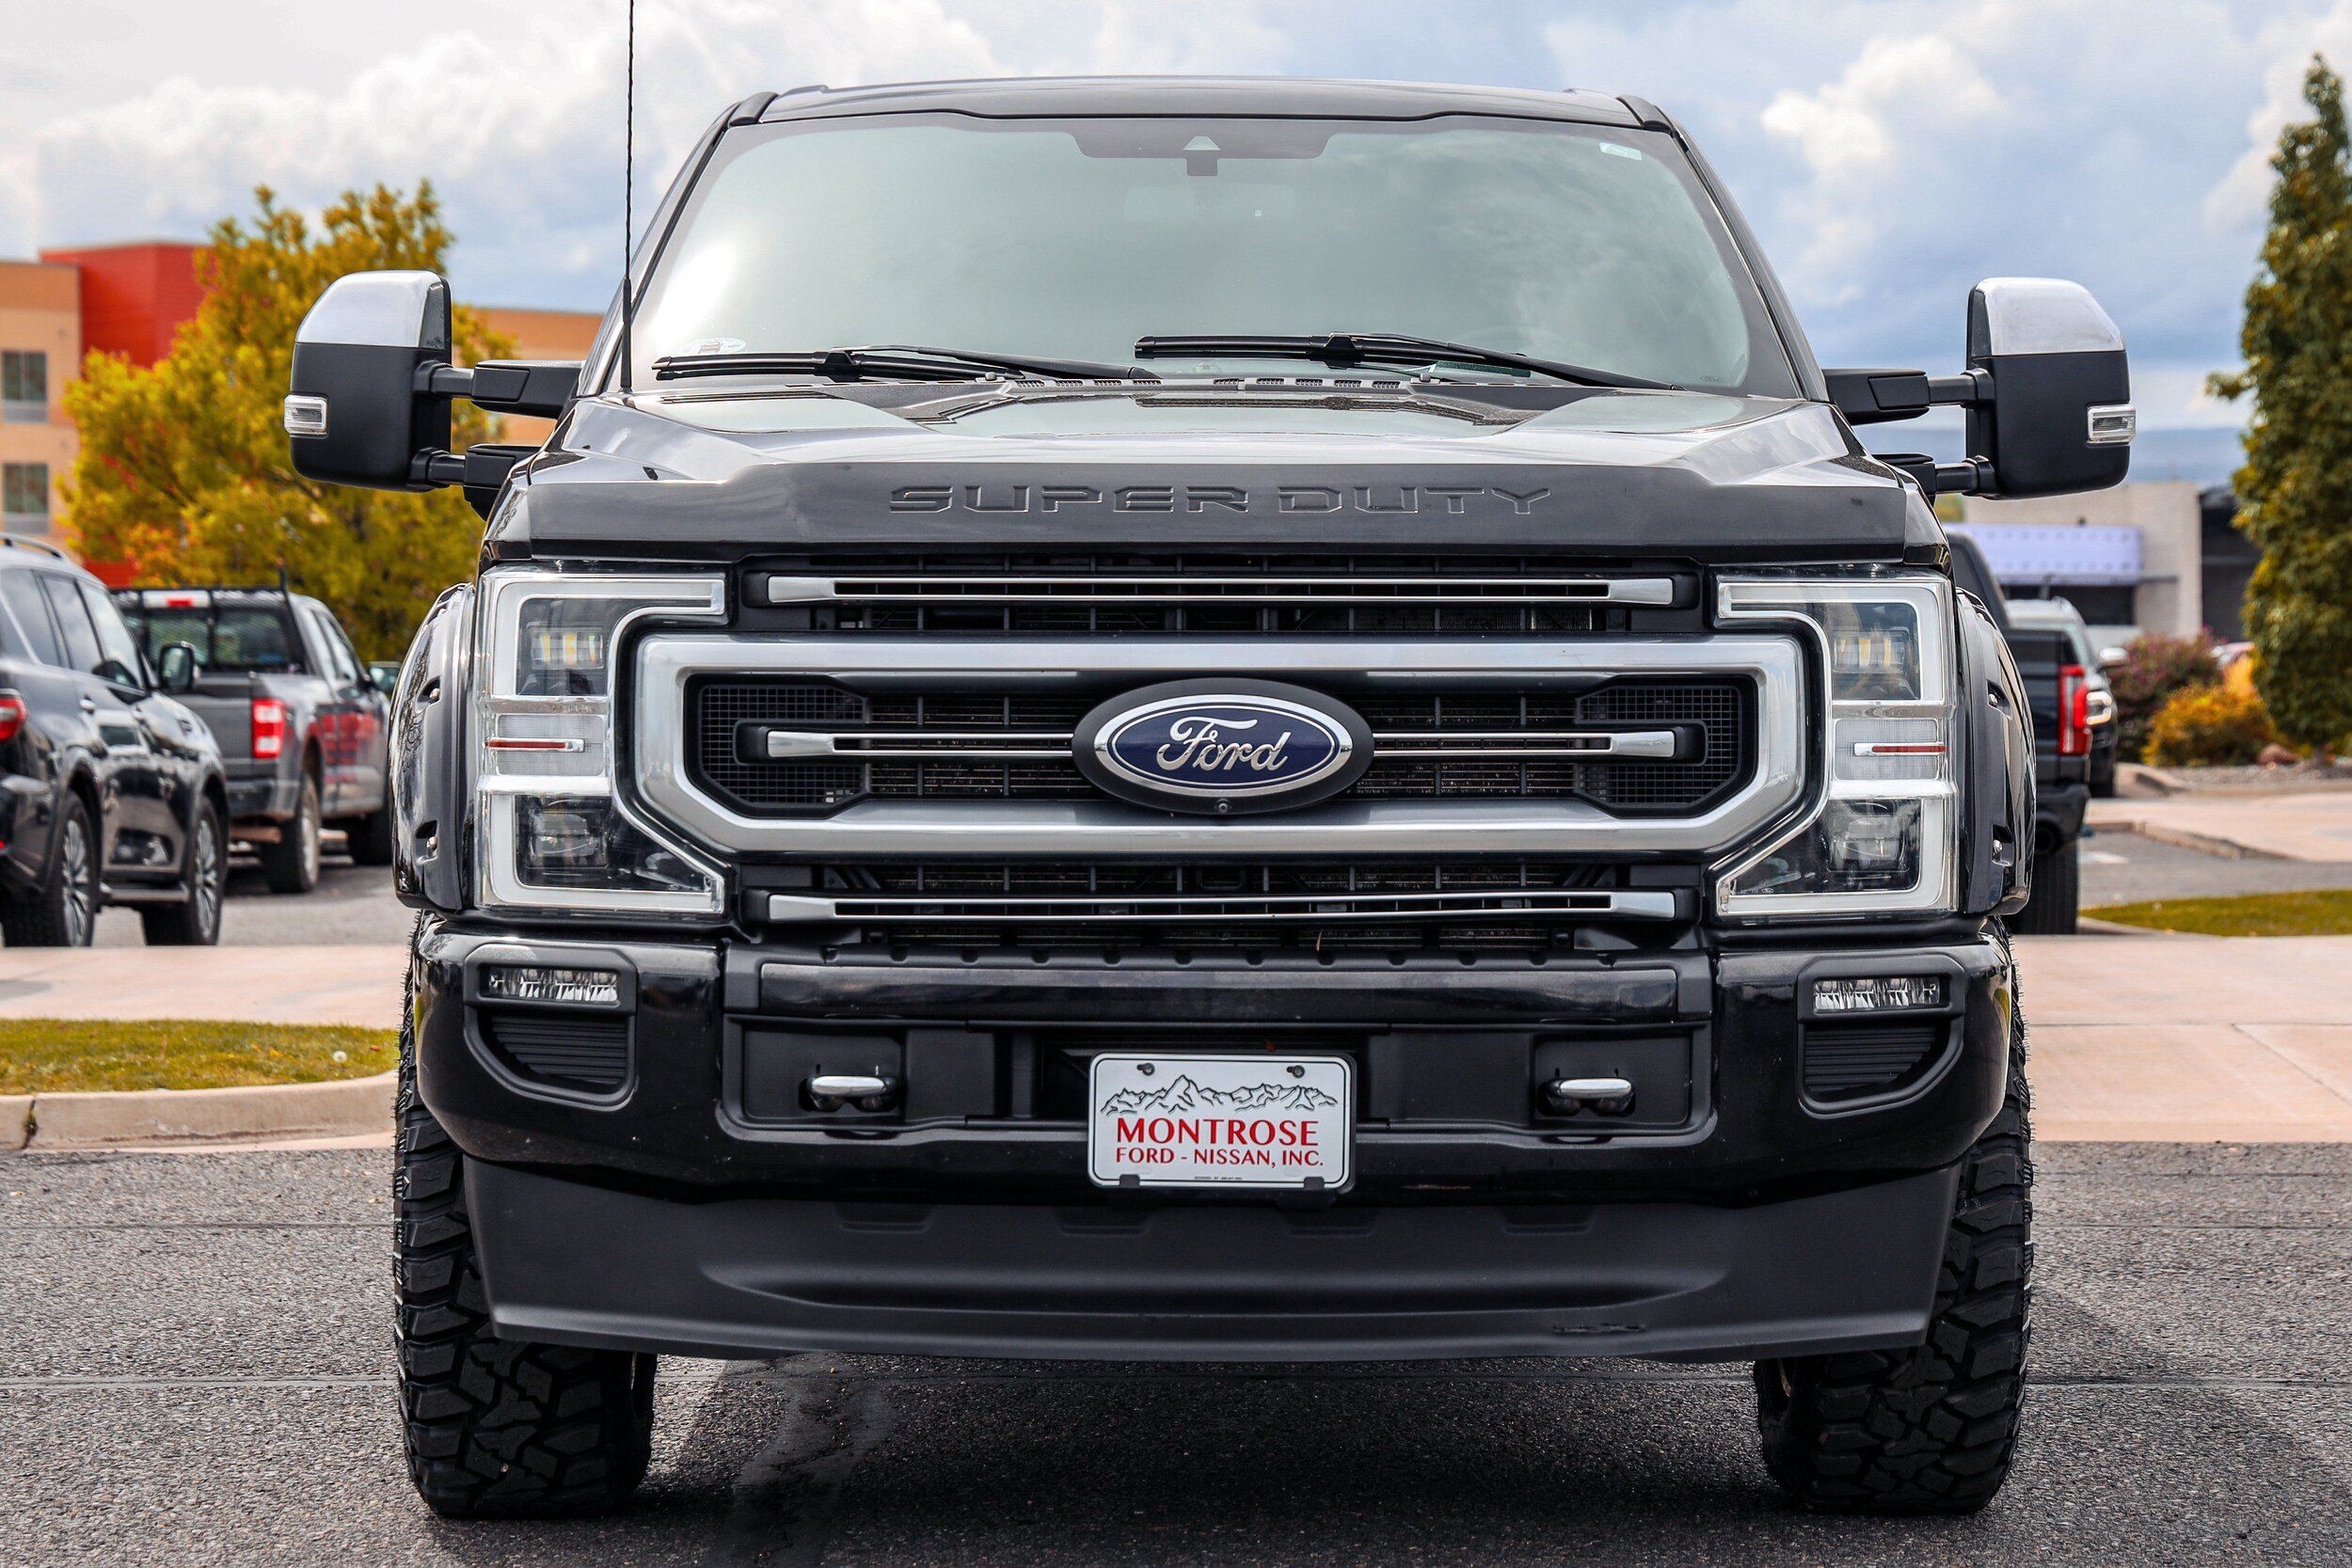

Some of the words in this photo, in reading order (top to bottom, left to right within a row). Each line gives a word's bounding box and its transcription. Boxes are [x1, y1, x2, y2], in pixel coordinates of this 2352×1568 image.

[890, 484, 1248, 514] SUPER
[1278, 485, 1551, 515] DUTY
[1156, 716, 1292, 771] Ford
[1117, 1117, 1319, 1147] MONTROSE
[1116, 1147, 1175, 1164] FORD
[1194, 1148, 1277, 1169] NISSAN,
[1282, 1149, 1324, 1167] INC.
